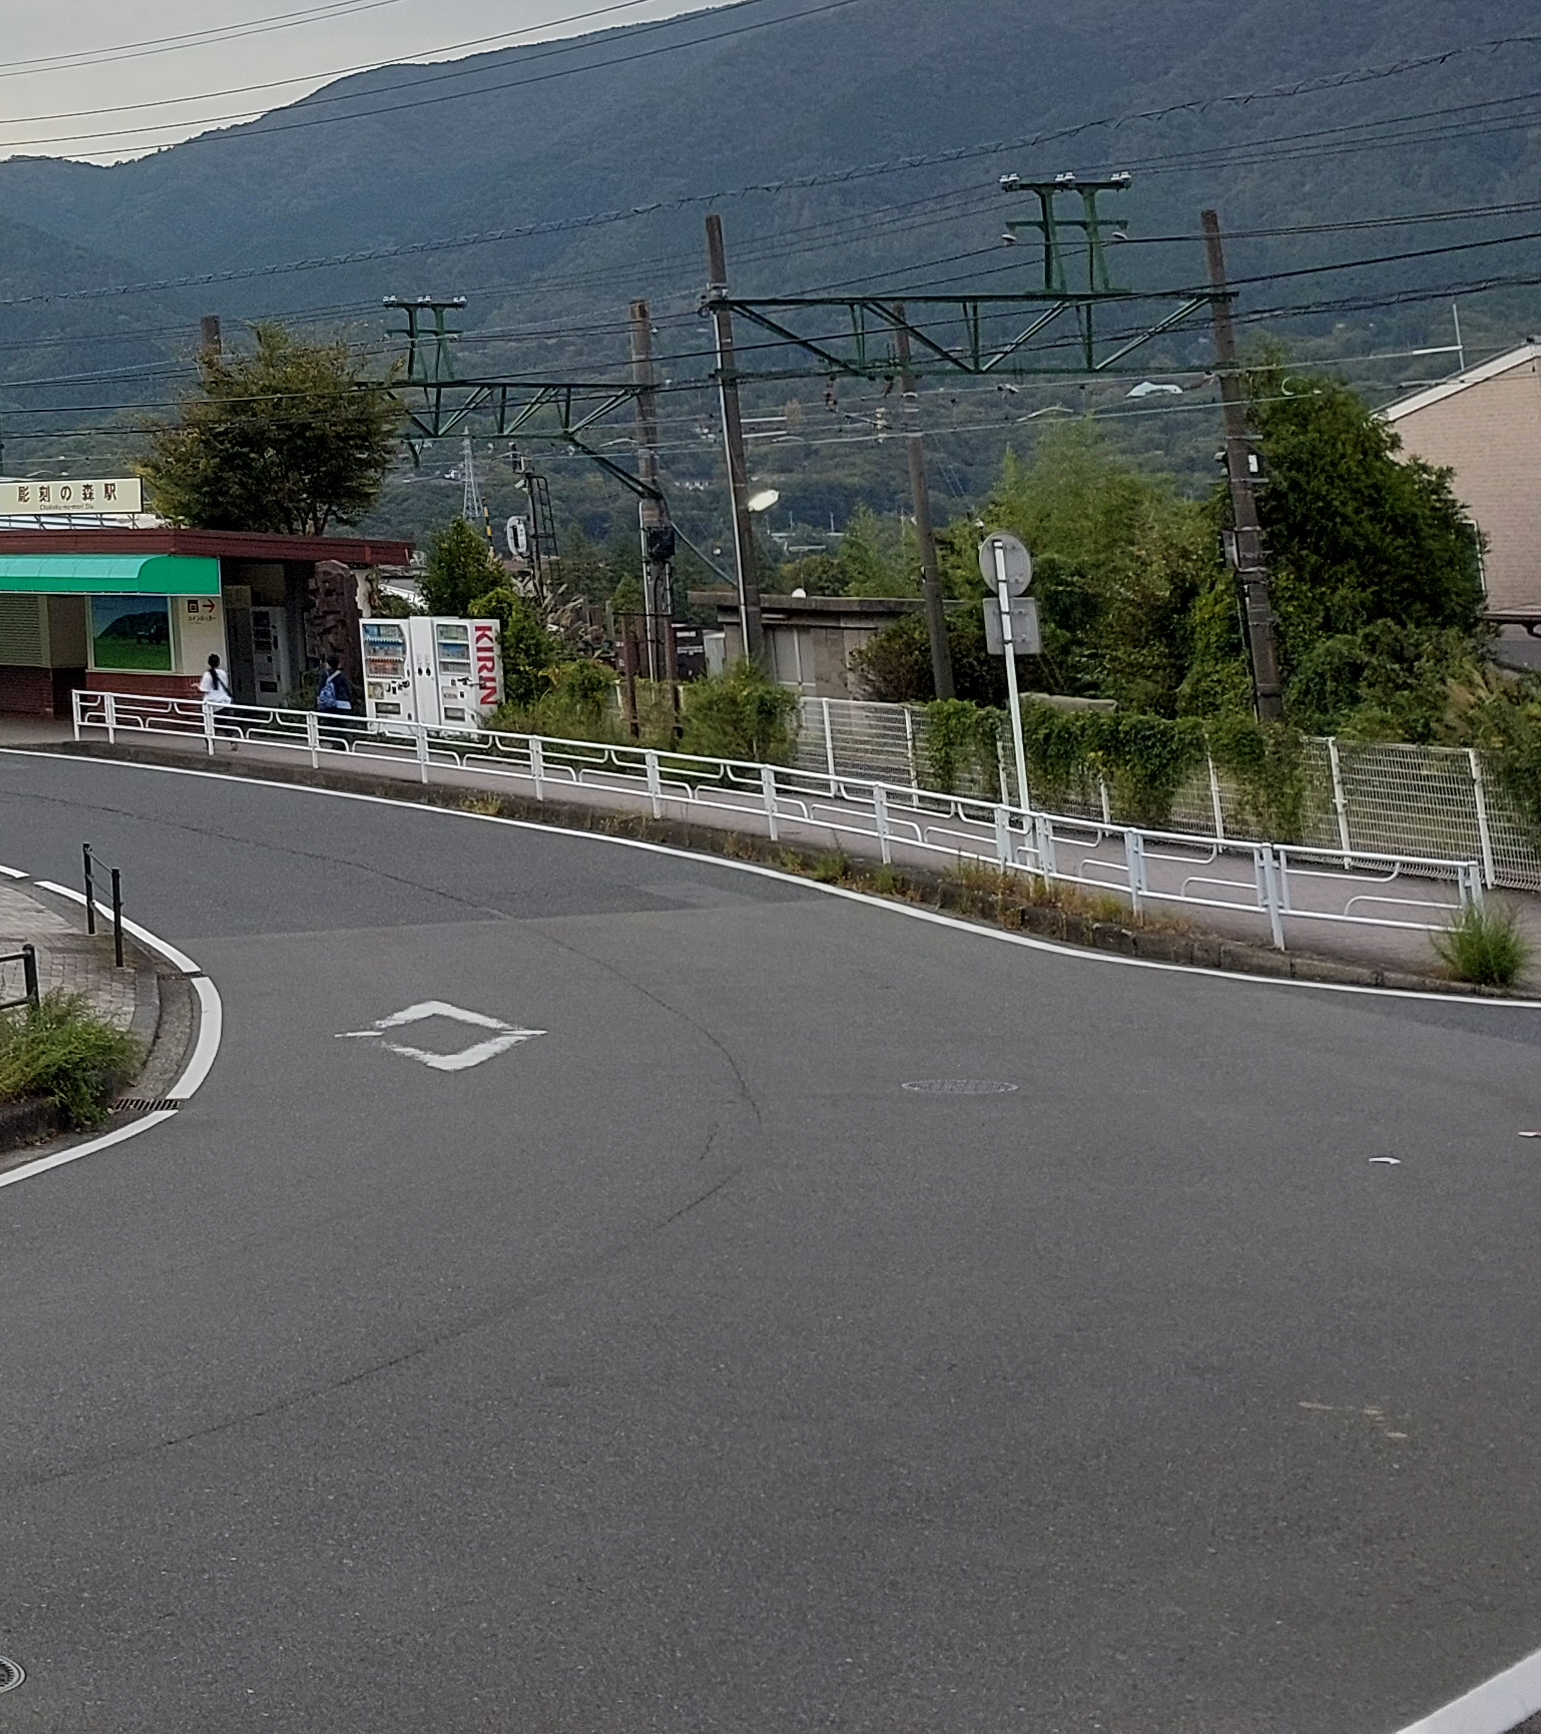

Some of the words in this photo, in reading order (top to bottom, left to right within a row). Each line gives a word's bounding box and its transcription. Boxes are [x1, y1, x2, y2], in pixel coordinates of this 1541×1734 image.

[18, 482, 117, 503] 彫刻の森駅
[474, 625, 499, 705] KIRIN
